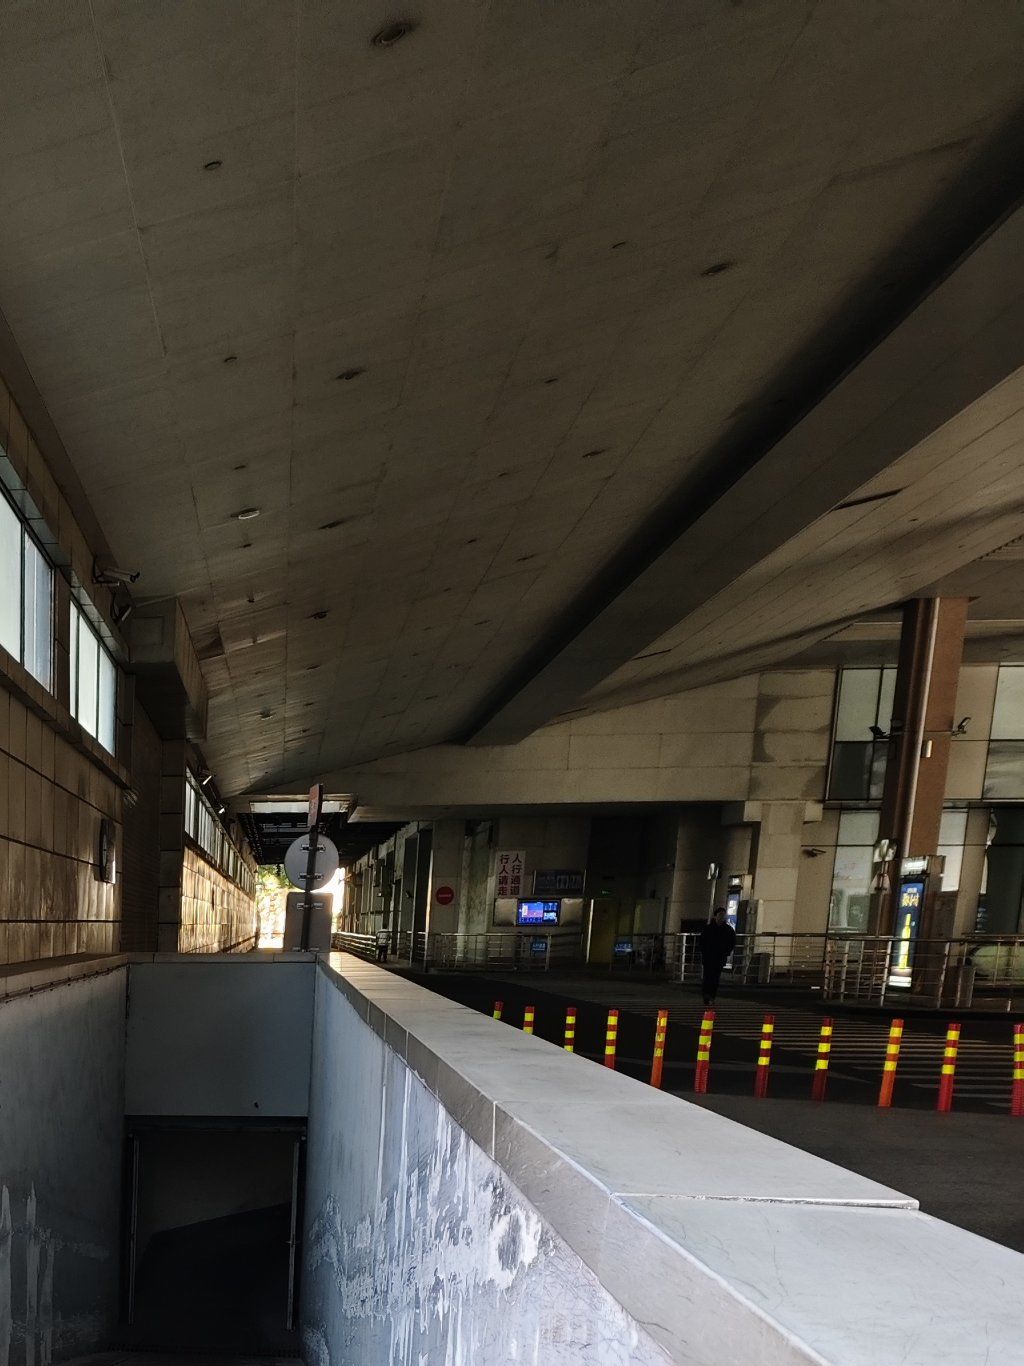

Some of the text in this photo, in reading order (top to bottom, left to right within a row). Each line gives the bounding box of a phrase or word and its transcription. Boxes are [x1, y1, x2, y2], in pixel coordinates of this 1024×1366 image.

[497, 854, 509, 896] 行人请走
[510, 852, 522, 895] 人行通道
